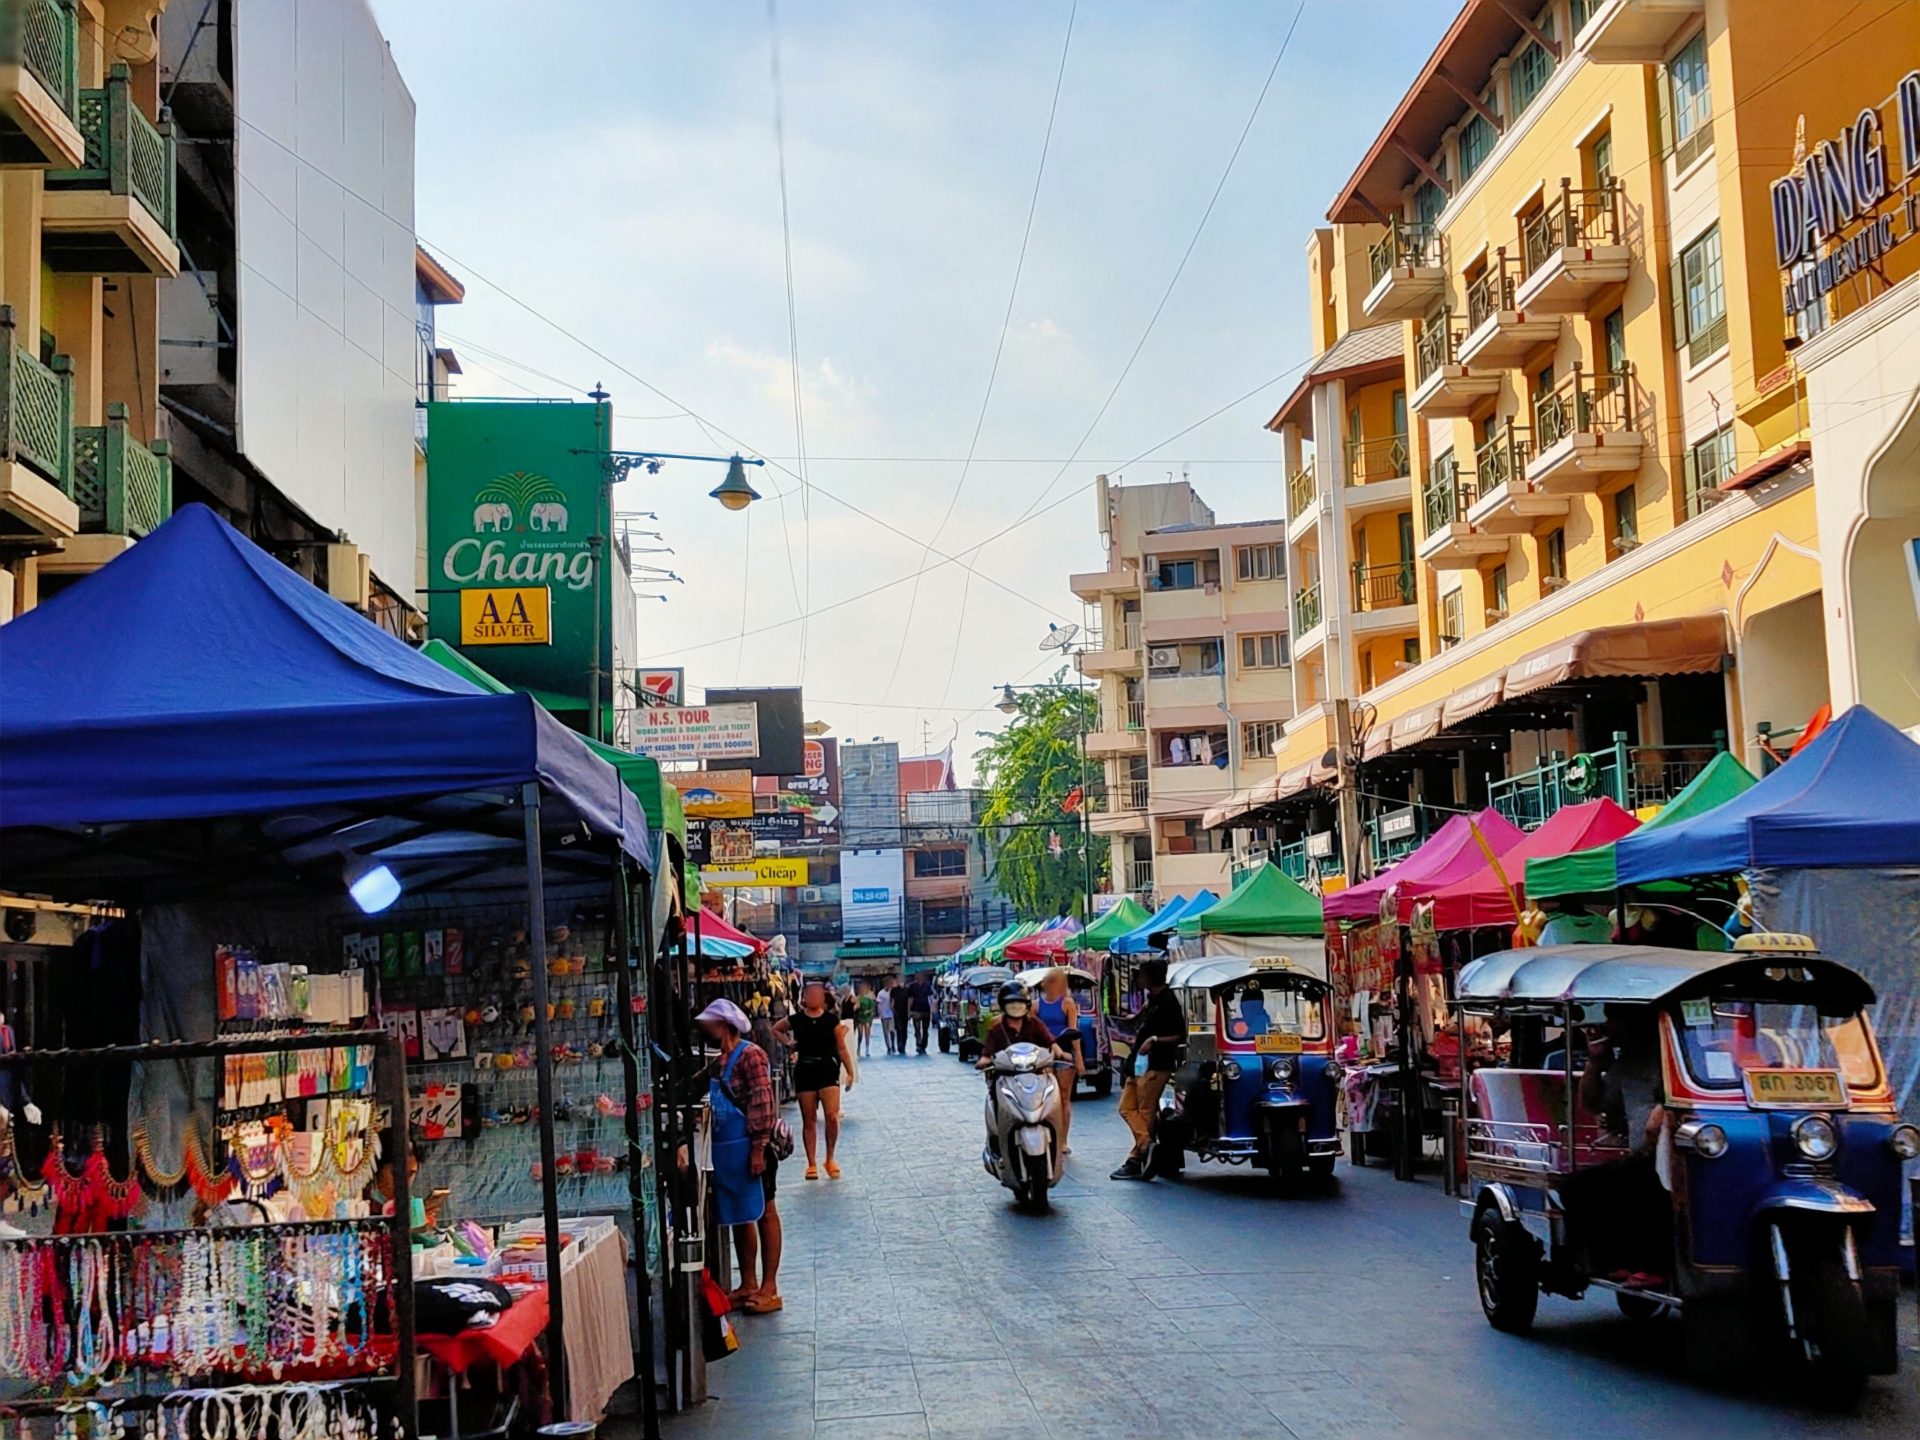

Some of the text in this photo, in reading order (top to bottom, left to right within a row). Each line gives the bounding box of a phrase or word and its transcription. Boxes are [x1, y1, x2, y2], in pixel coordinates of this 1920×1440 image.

[1772, 107, 1885, 270] DANG
[1785, 212, 1896, 317] AUTHENTIC
[443, 538, 594, 590] Chang
[474, 624, 536, 638] SILVER
[649, 710, 710, 726] N.S. TOUR
[635, 728, 659, 736] WORLD
[661, 727, 676, 735] WIDE
[686, 725, 717, 733] DOMESTIC
[718, 724, 729, 732] AIR
[730, 723, 751, 731] TICKET
[661, 735, 680, 743] TICKET
[682, 734, 701, 742] TRAIN
[634, 745, 653, 753] SIGHT
[654, 744, 676, 752] SEEING
[724, 740, 753, 748] BOOKING
[787, 777, 829, 791] OPEN 24
[767, 816, 799, 827] Galaxy
[761, 865, 797, 881] Cheap
[1755, 935, 1807, 946] TAXI
[1260, 957, 1286, 965] TAXI
[1793, 1074, 1837, 1092] 3067
